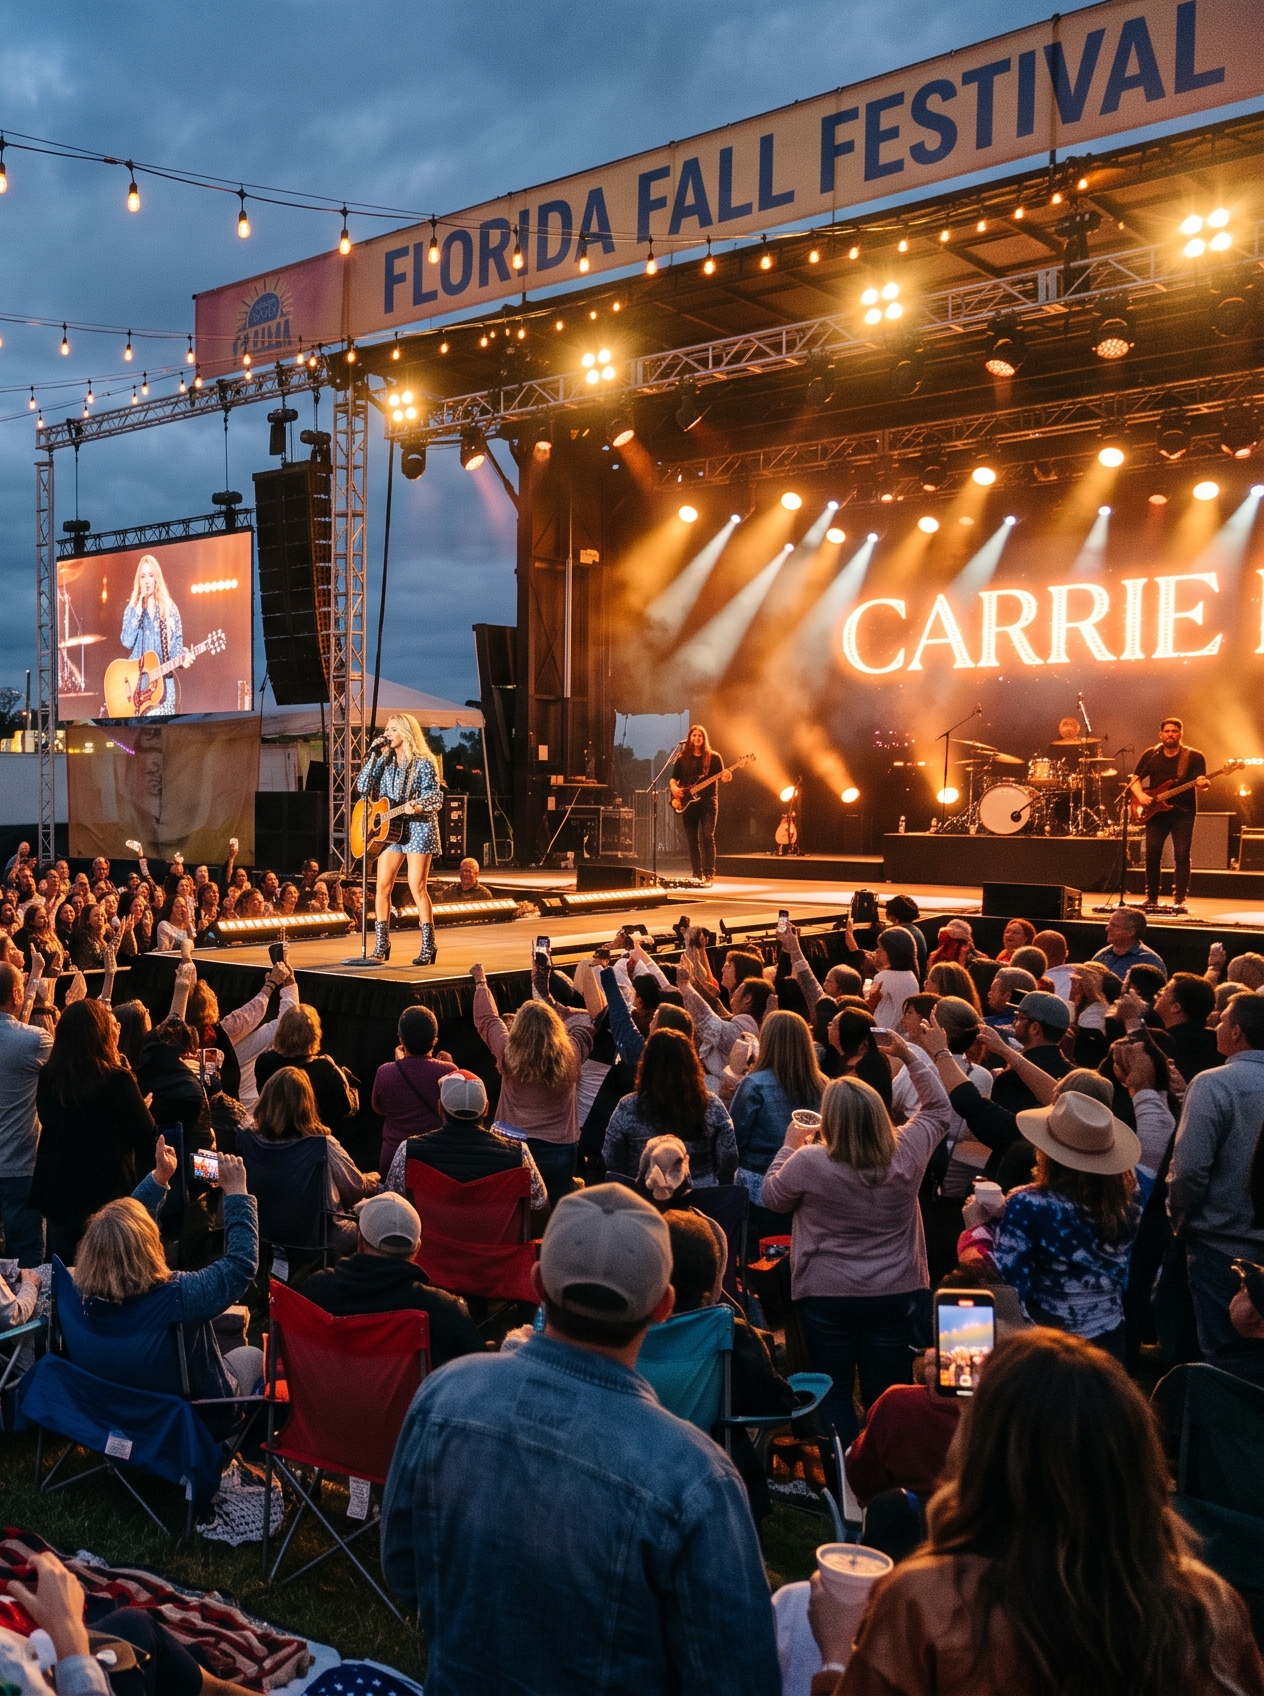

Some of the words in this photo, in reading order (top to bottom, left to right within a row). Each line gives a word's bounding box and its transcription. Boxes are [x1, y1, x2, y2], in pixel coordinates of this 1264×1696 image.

[384, 187, 616, 314] FLORIDA
[636, 133, 795, 244] FALL
[820, 0, 1226, 194] FESTIVAL
[841, 572, 1223, 674] CARRIE
